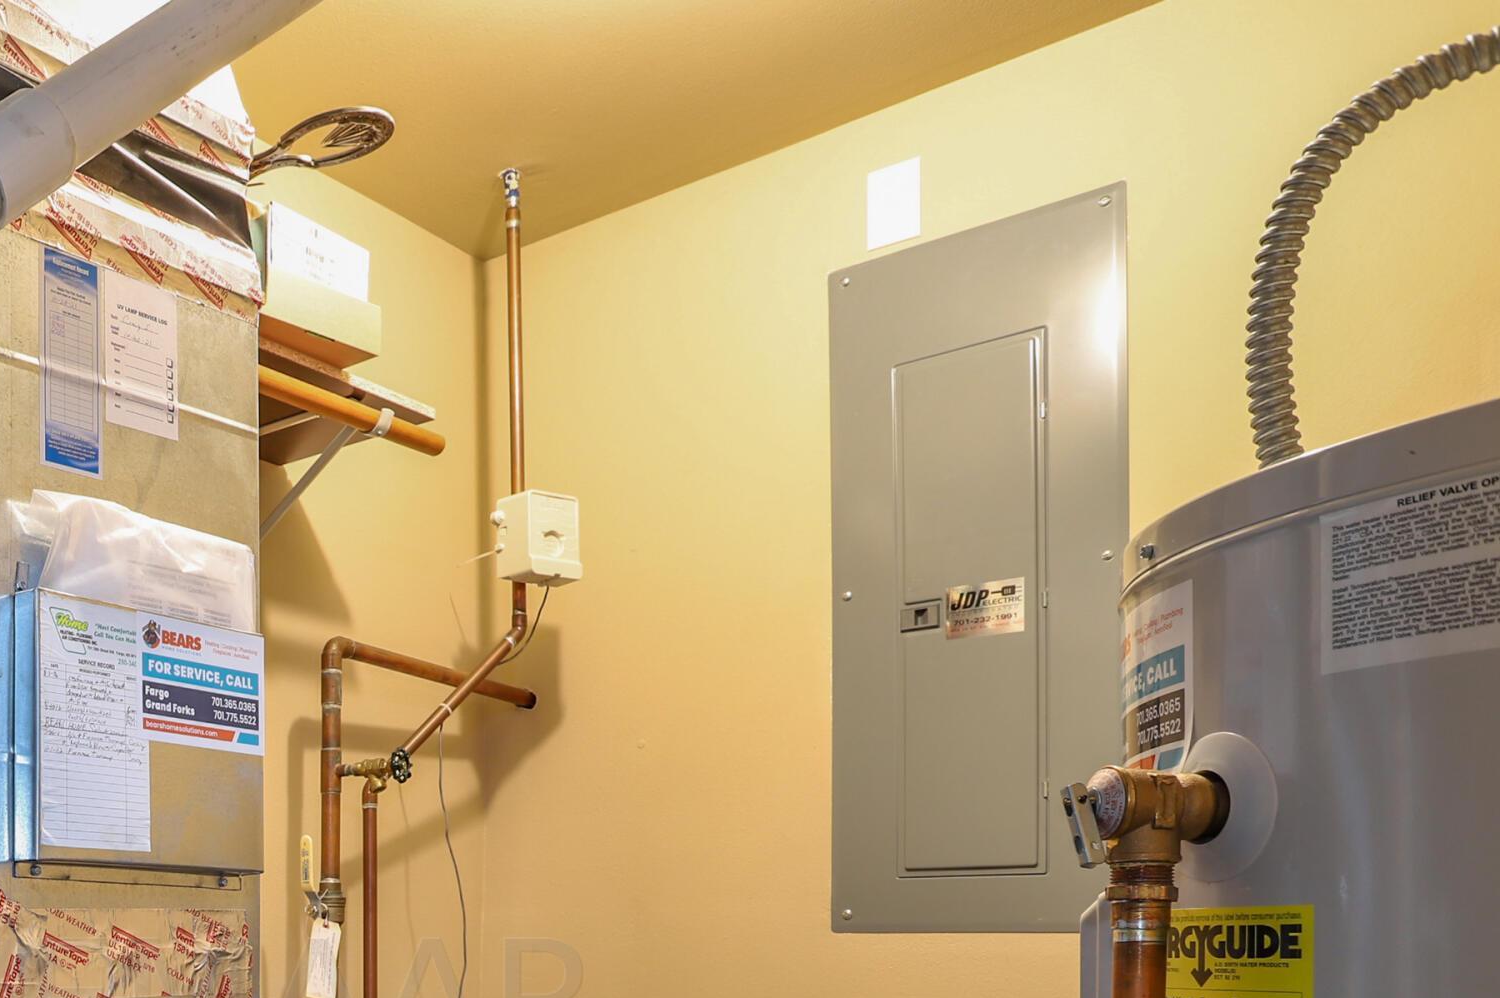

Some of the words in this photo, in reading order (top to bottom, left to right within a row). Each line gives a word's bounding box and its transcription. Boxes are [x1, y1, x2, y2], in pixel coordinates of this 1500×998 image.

[1396, 489, 1436, 508] RELIEF
[1439, 480, 1478, 497] VALVE
[950, 589, 990, 612] JDP
[982, 595, 1023, 607] ELECTRIC
[56, 612, 89, 632] Home
[161, 629, 202, 651] BEARS
[78, 658, 97, 668] SERVICE
[97, 661, 116, 671] RECORD
[148, 659, 172, 675] FOR
[173, 665, 224, 687] SERVICE,
[225, 674, 254, 690] CALL
[1146, 657, 1178, 686] CALL
[145, 685, 170, 700] Fargo
[145, 699, 172, 713] Grand
[172, 703, 196, 716] Forks
[211, 696, 257, 713] 701.365.0365
[213, 709, 257, 726] 701.775.5522
[65, 915, 97, 937] WEATHER
[110, 929, 161, 961] VentureTape
[1167, 924, 1303, 959] RGYGUIDE
[1258, 961, 1290, 969] PRODUCTS
